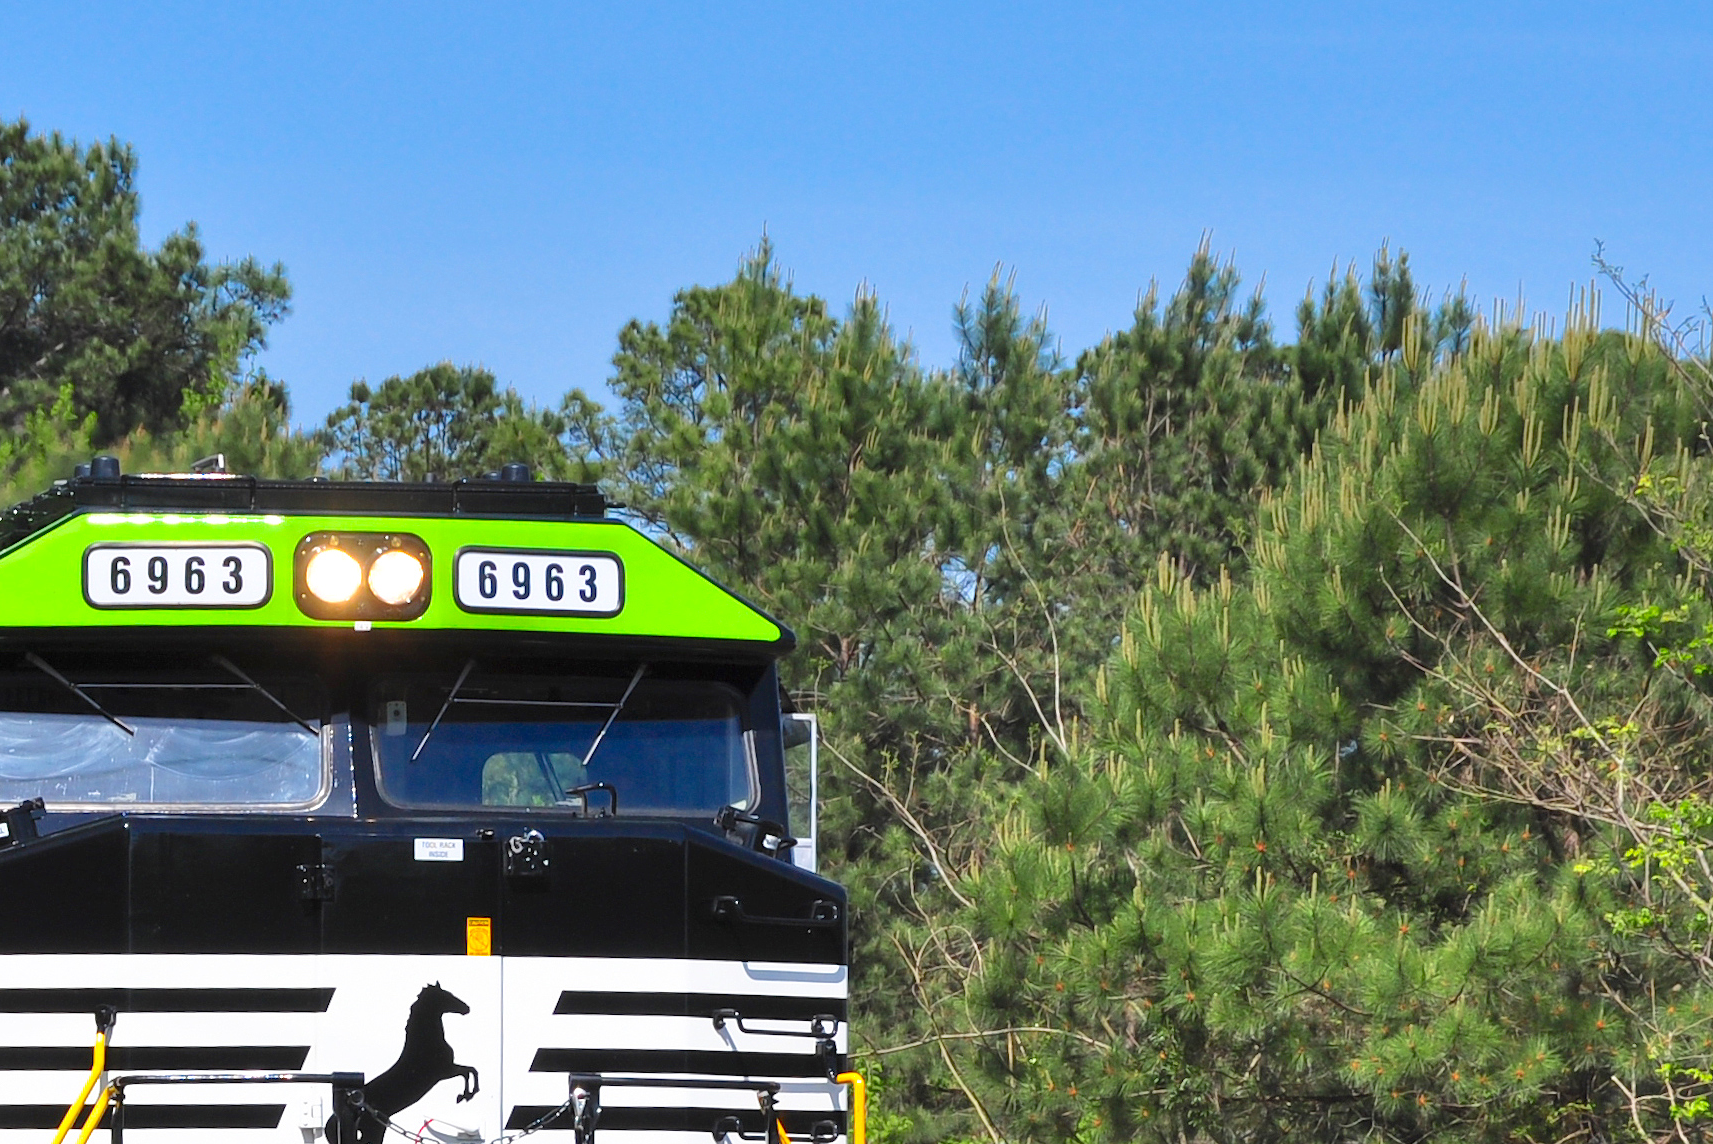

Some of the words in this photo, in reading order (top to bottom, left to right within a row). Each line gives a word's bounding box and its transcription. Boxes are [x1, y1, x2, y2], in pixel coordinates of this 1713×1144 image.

[110, 556, 243, 594] 6963
[479, 560, 597, 603] 6963
[422, 841, 437, 849] TOOL
[439, 841, 456, 849] RACK
